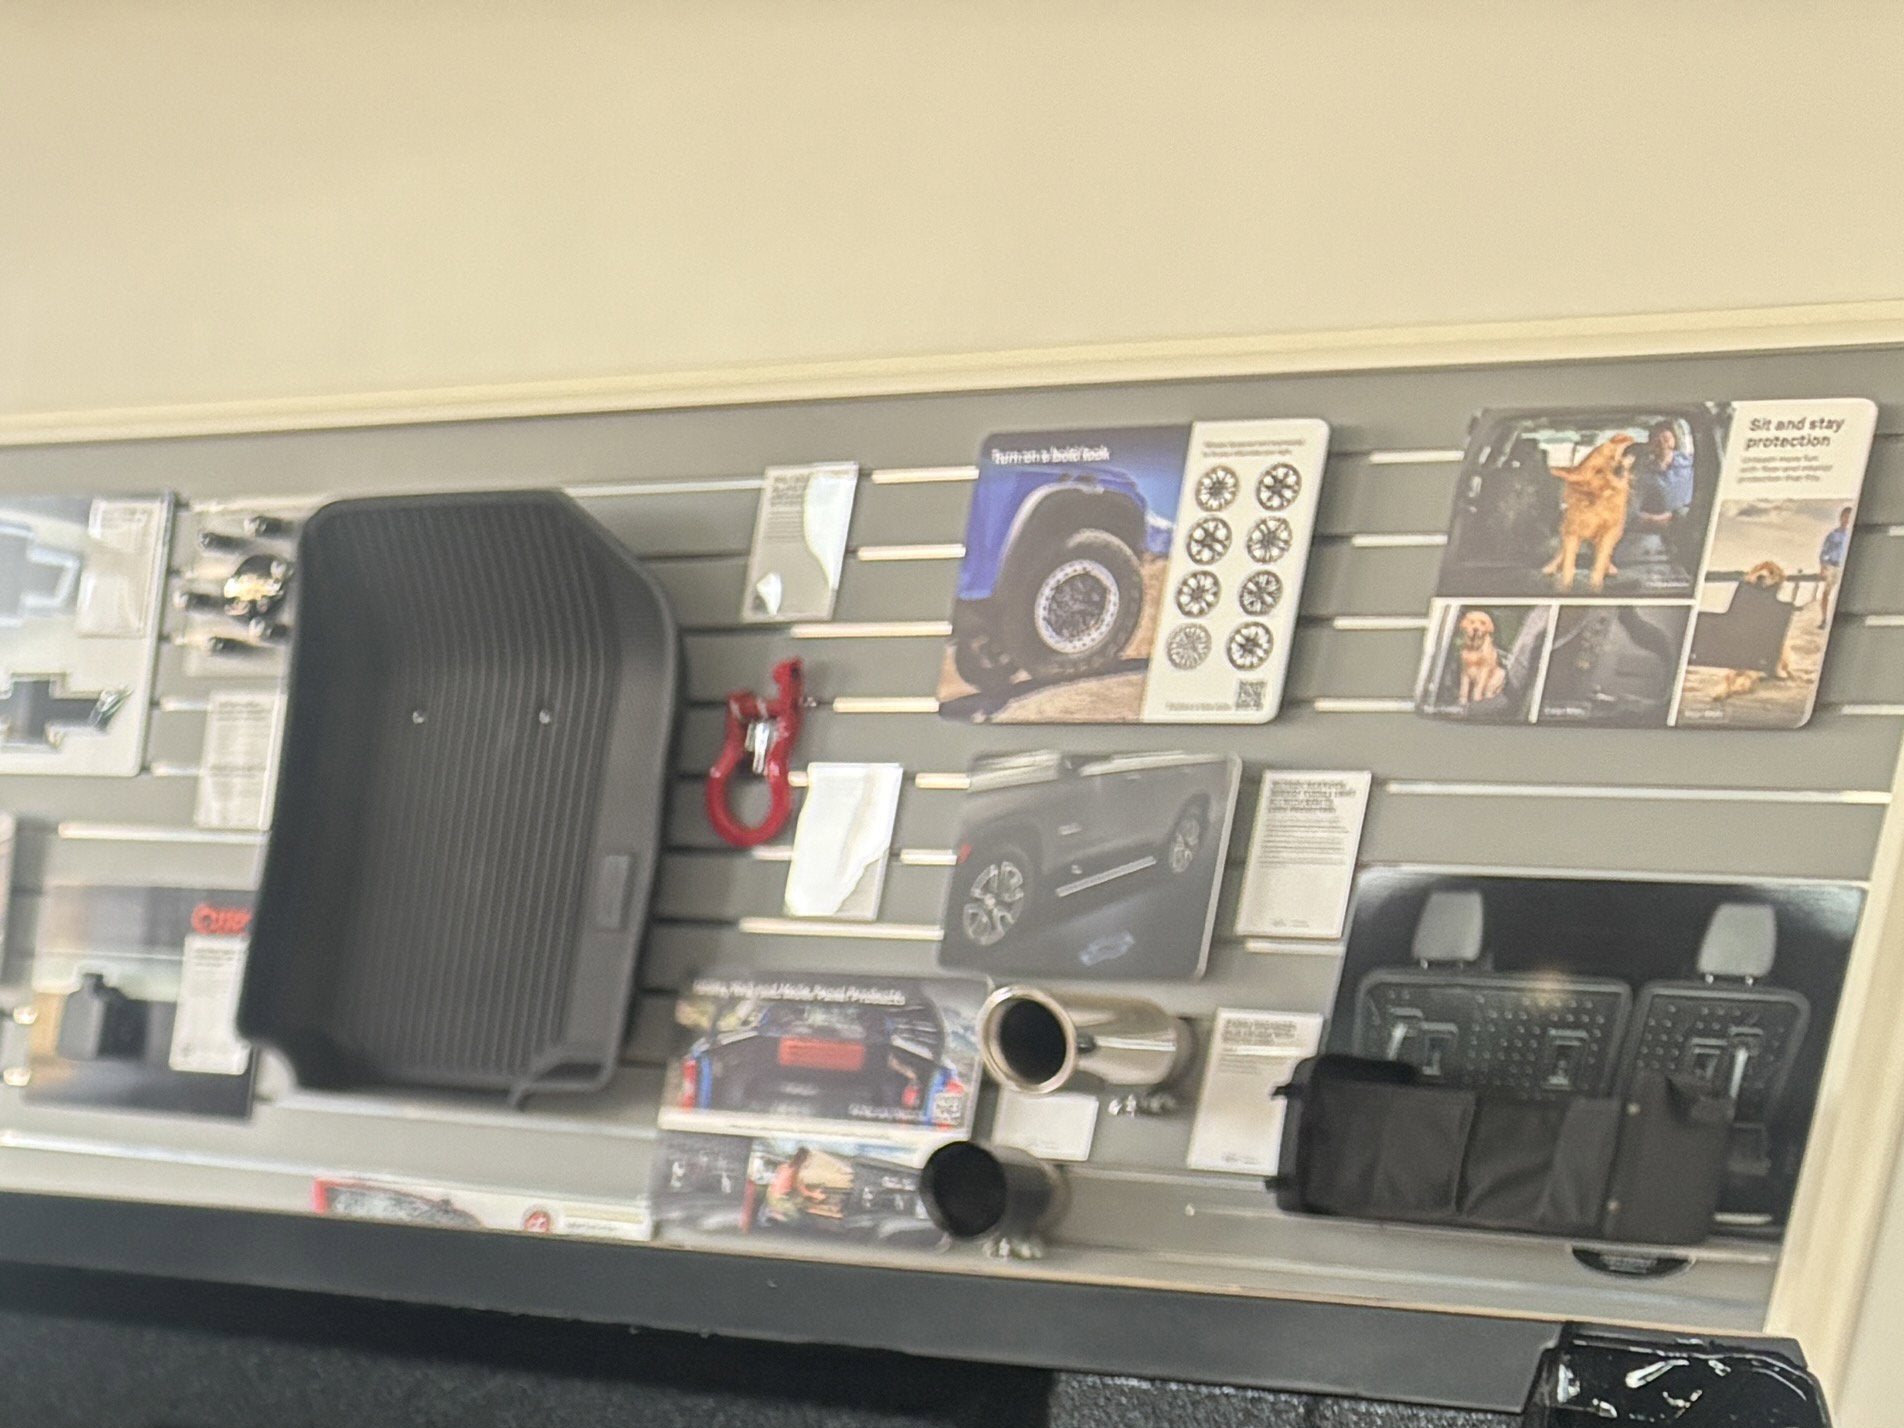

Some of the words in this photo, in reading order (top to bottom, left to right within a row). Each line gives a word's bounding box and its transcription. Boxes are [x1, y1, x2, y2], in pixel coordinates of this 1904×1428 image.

[1750, 417, 1771, 431] Sit
[1775, 416, 1806, 431] and
[1809, 417, 1845, 433] stay
[1745, 434, 1831, 450] protection
